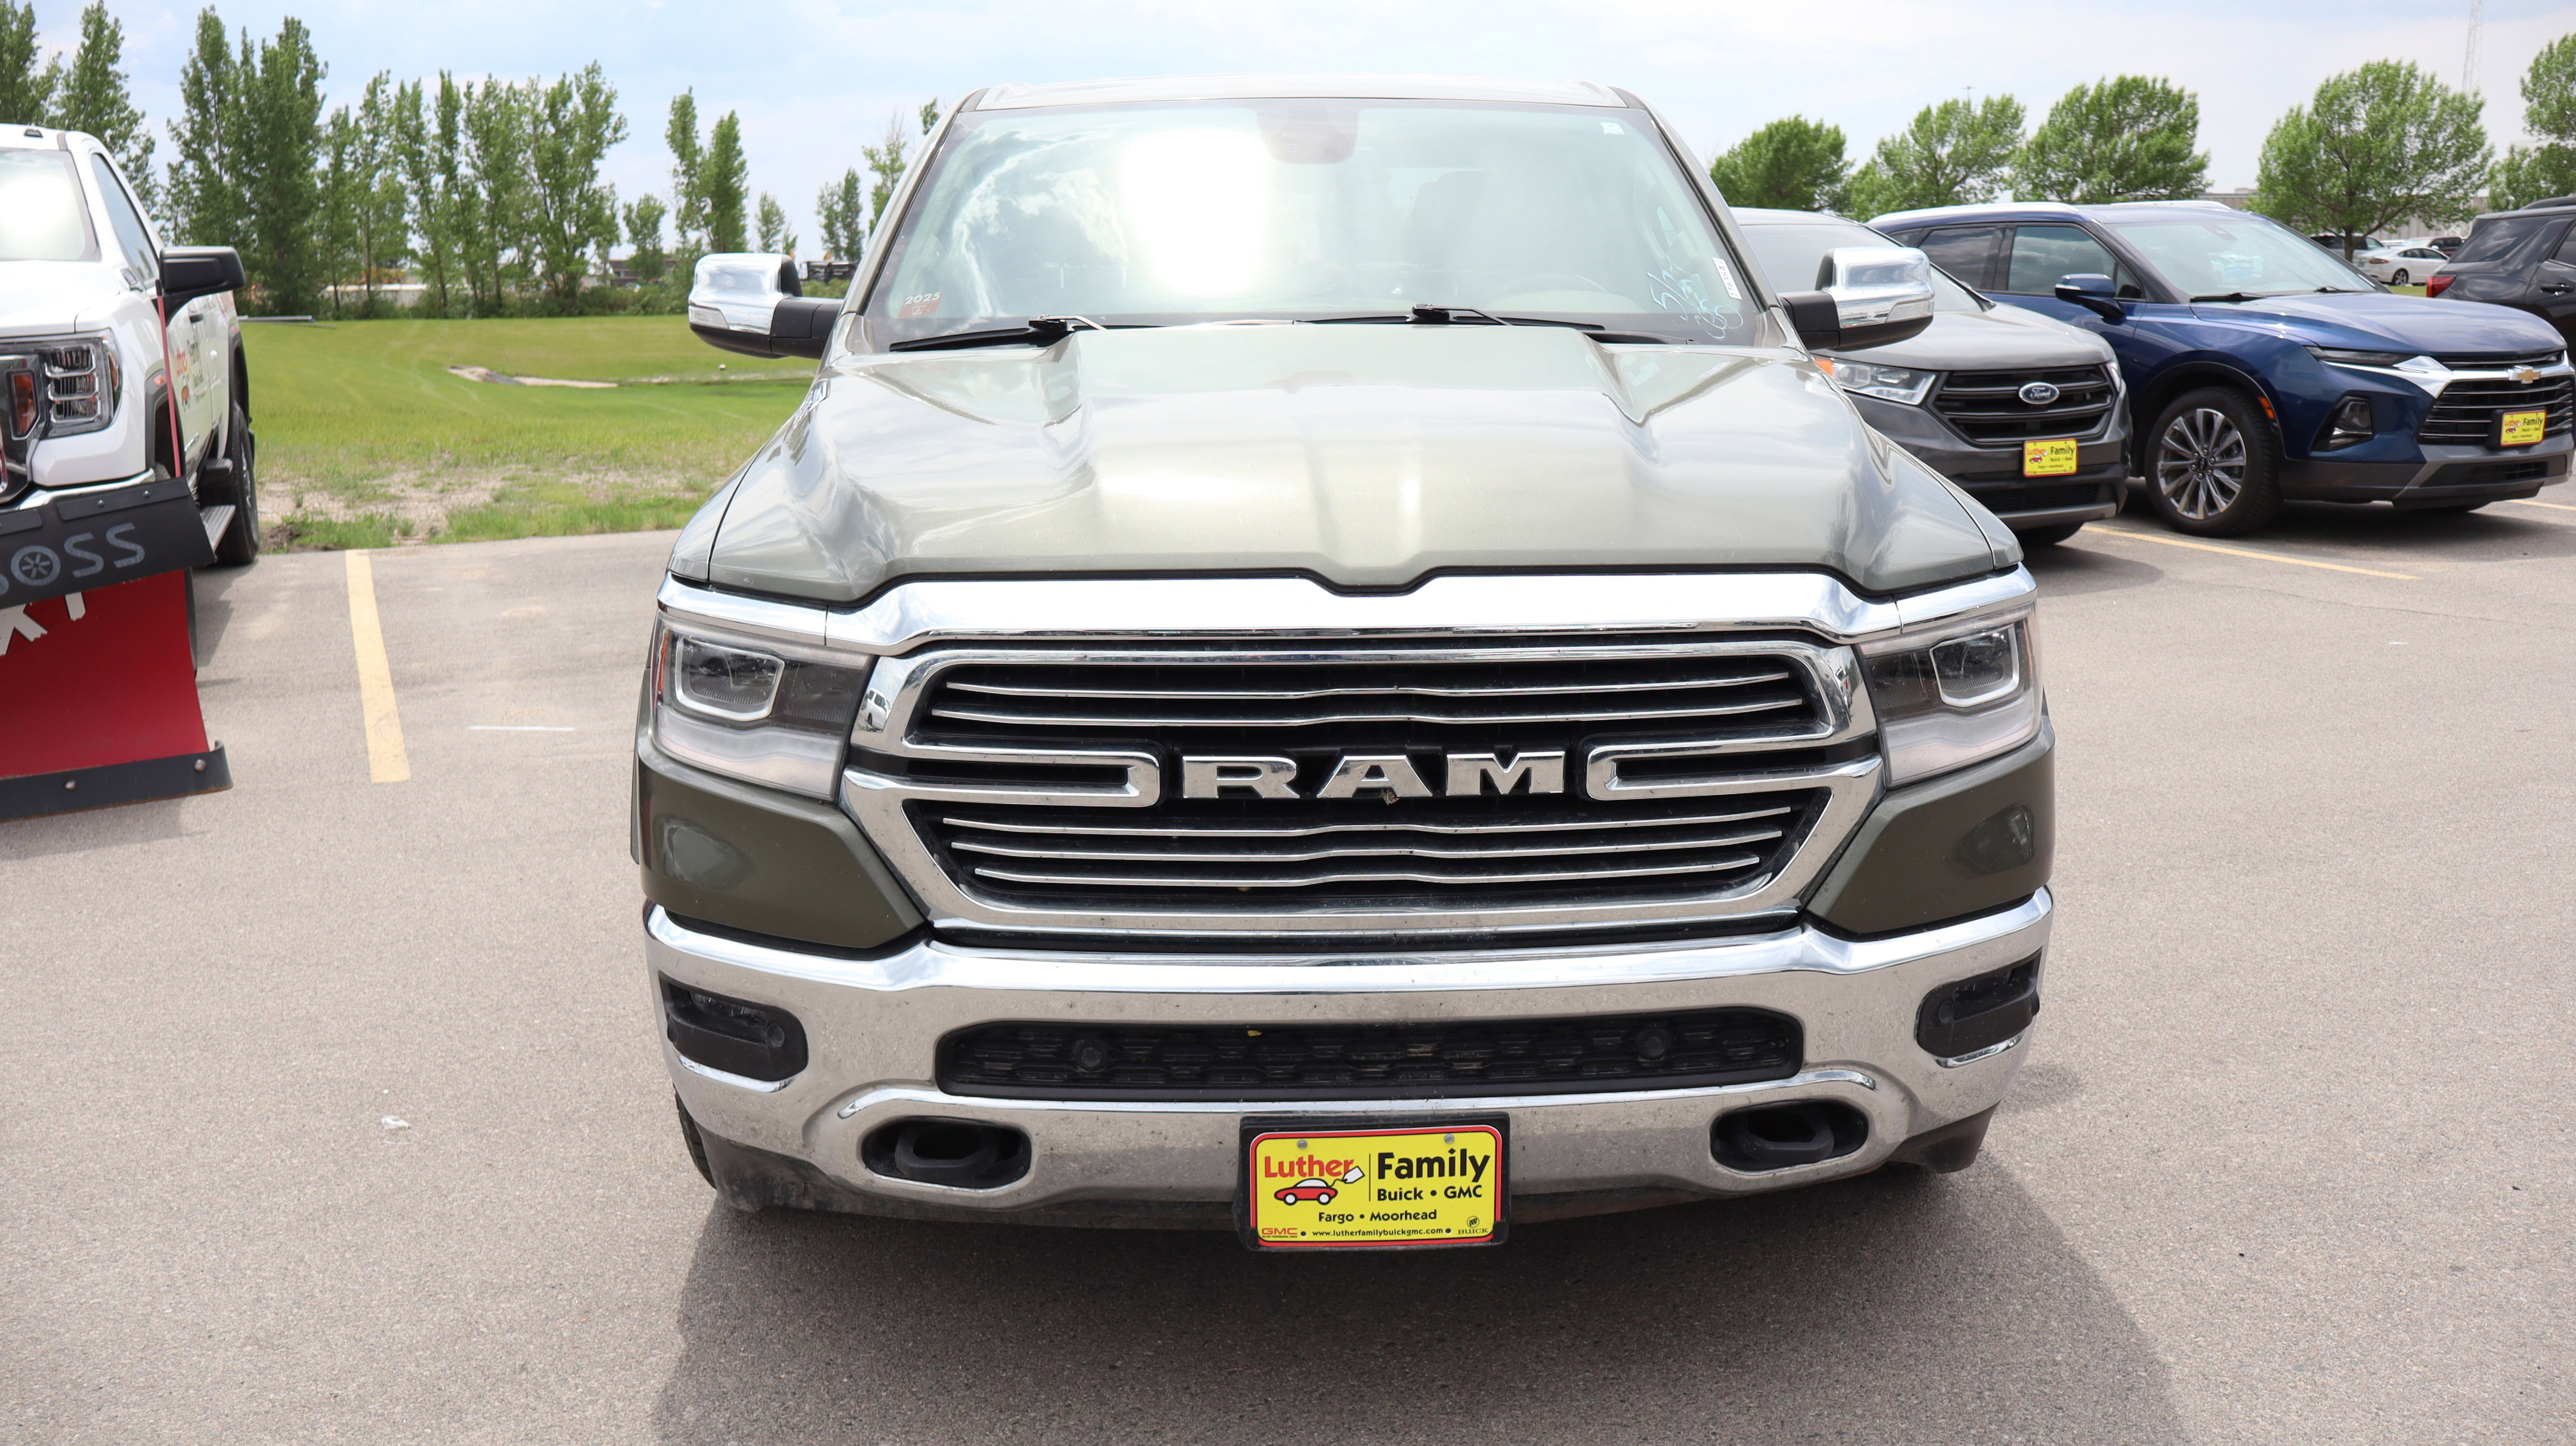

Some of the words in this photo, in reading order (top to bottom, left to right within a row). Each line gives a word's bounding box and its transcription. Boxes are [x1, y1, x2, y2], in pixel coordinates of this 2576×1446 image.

[904, 293, 941, 304] 2025
[2029, 387, 2051, 399] Ford
[2523, 417, 2543, 427] Family
[2051, 446, 2075, 456] Family
[0, 522, 145, 596] OSS
[1182, 751, 1566, 798] RAM
[1265, 1154, 1354, 1178] Luther
[1378, 1148, 1491, 1183] Family
[1377, 1187, 1424, 1201] Buick
[1444, 1185, 1483, 1199] GMC
[1319, 1212, 1354, 1224] Fargo
[1370, 1209, 1437, 1221] Moorhead
[1312, 1228, 1443, 1237] www.lutherfamilybuickgmc.com
